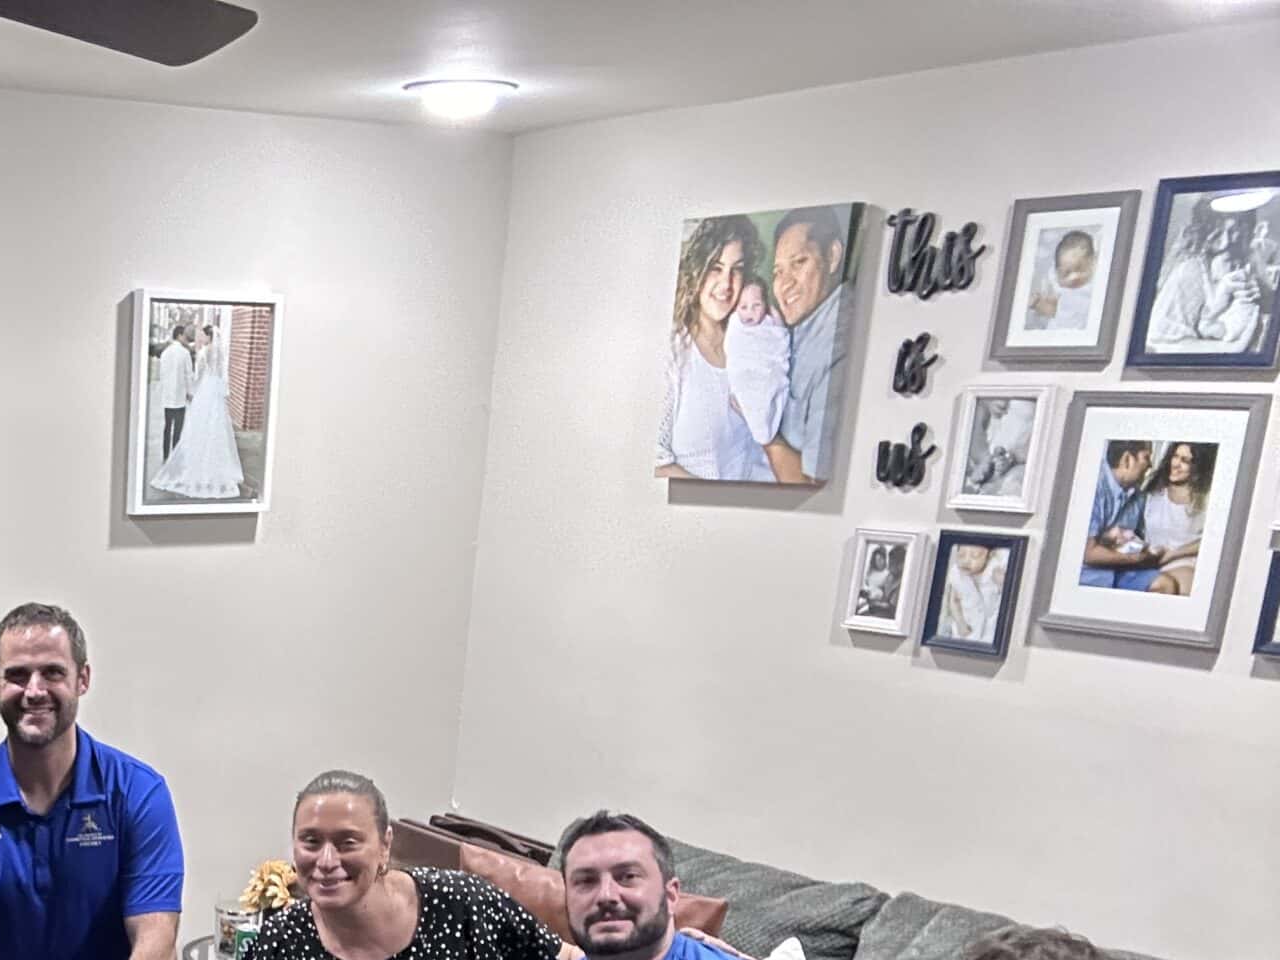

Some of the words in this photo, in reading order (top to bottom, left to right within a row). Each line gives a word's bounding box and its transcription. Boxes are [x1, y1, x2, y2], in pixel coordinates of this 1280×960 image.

[887, 208, 986, 300] this
[892, 332, 938, 395] is
[876, 422, 937, 488] us
